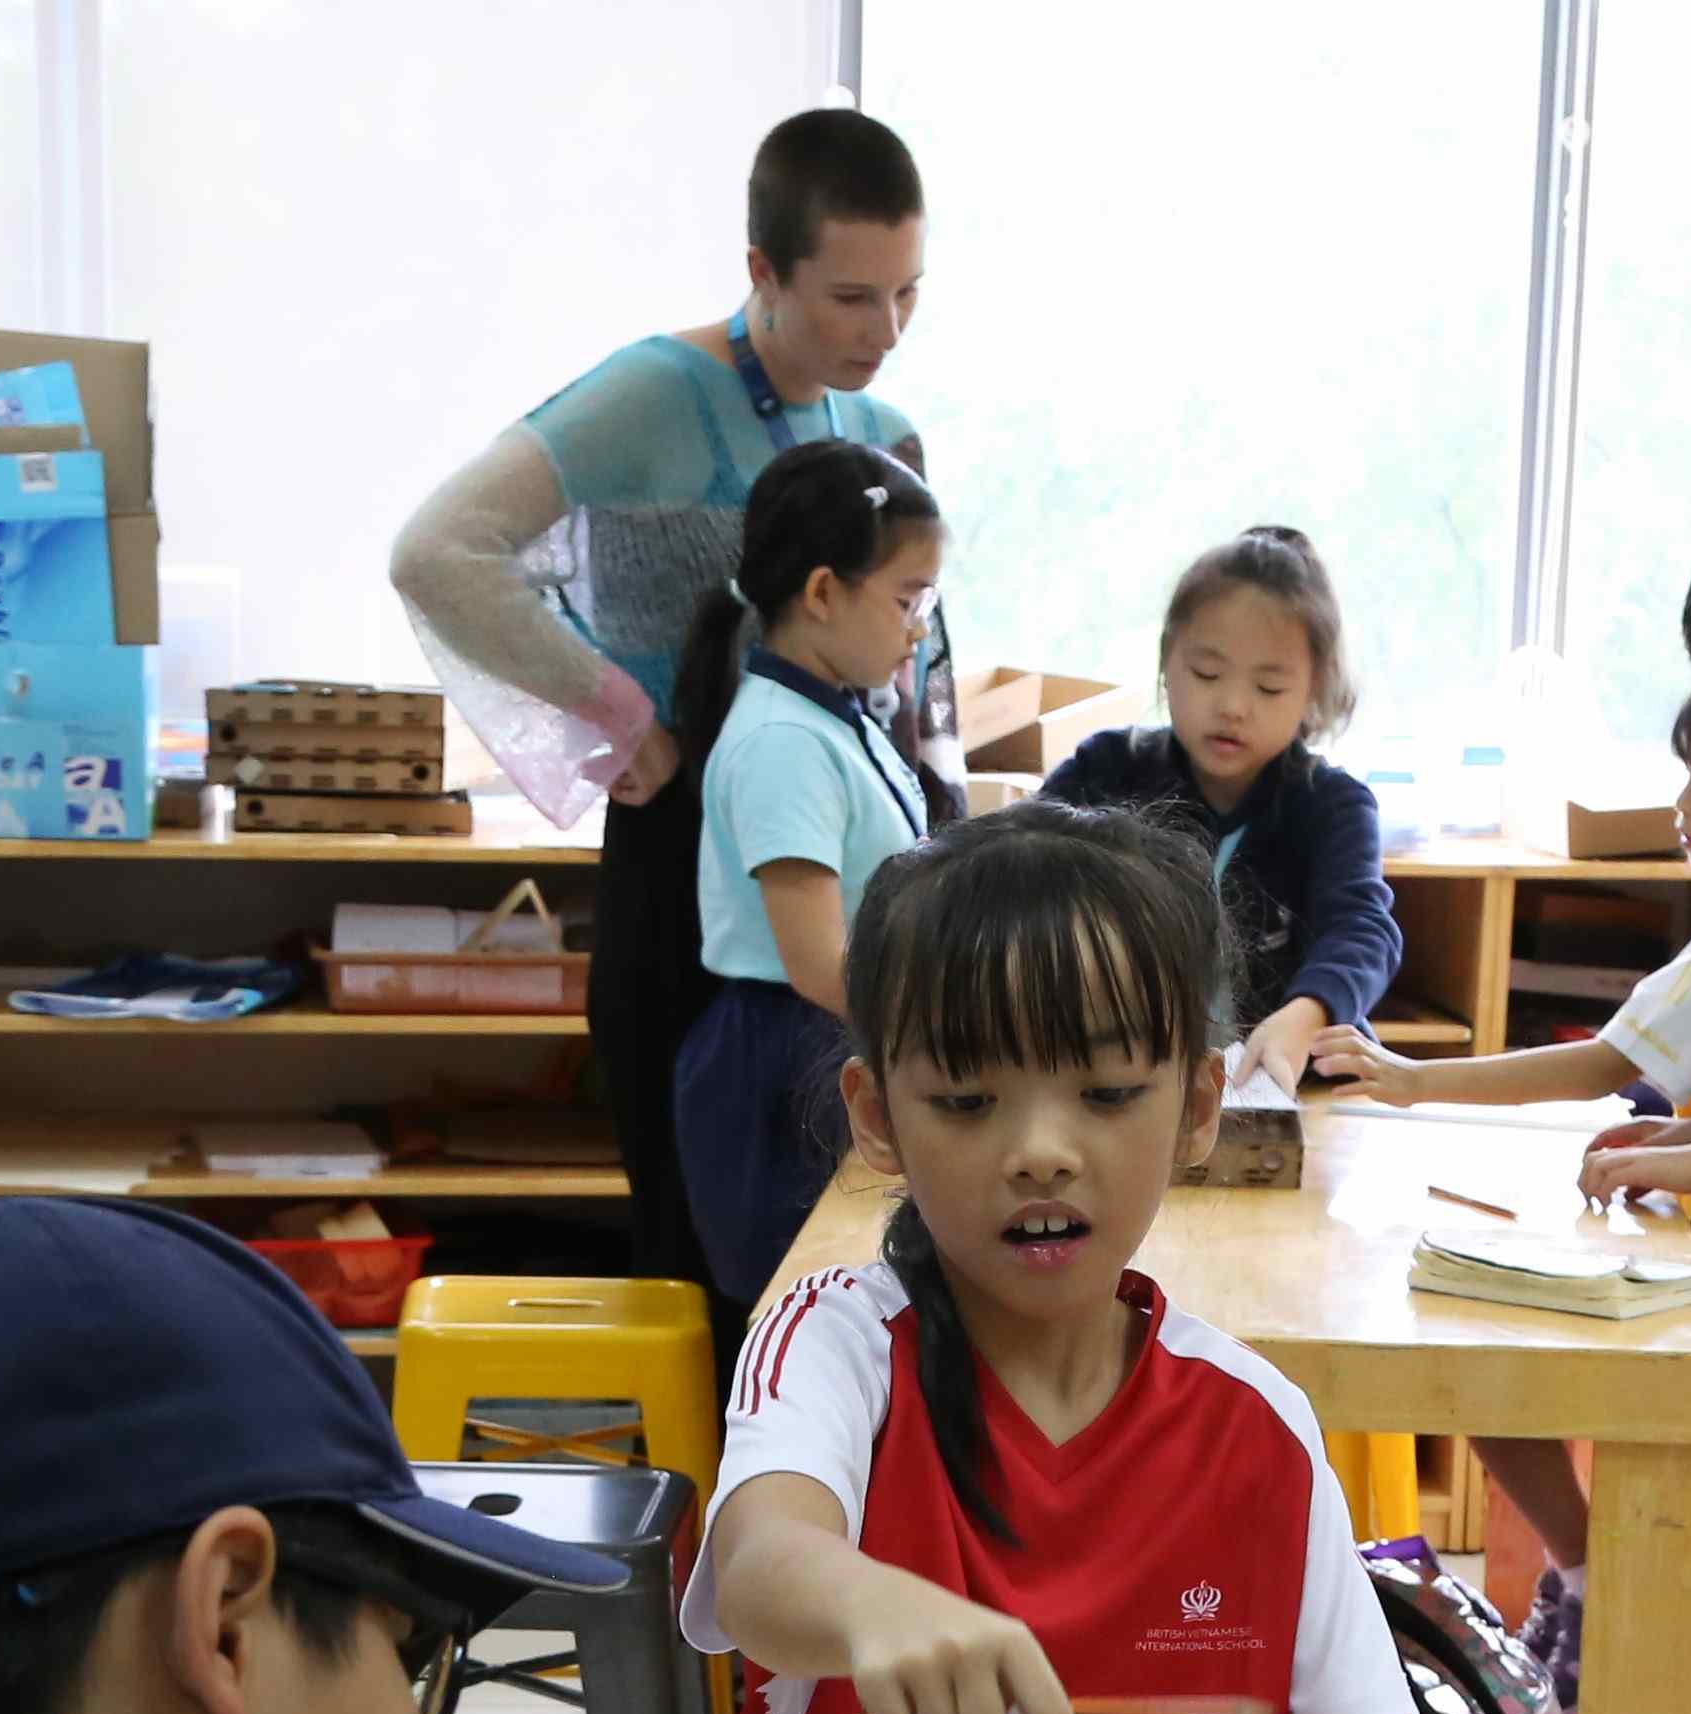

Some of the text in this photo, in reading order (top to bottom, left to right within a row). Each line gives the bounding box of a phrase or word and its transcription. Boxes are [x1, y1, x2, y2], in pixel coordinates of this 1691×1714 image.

[1145, 1626, 1252, 1640] BRITISH VIETNAMESE
[1134, 1639, 1268, 1652] INTERNATIONAL SCHOOL
